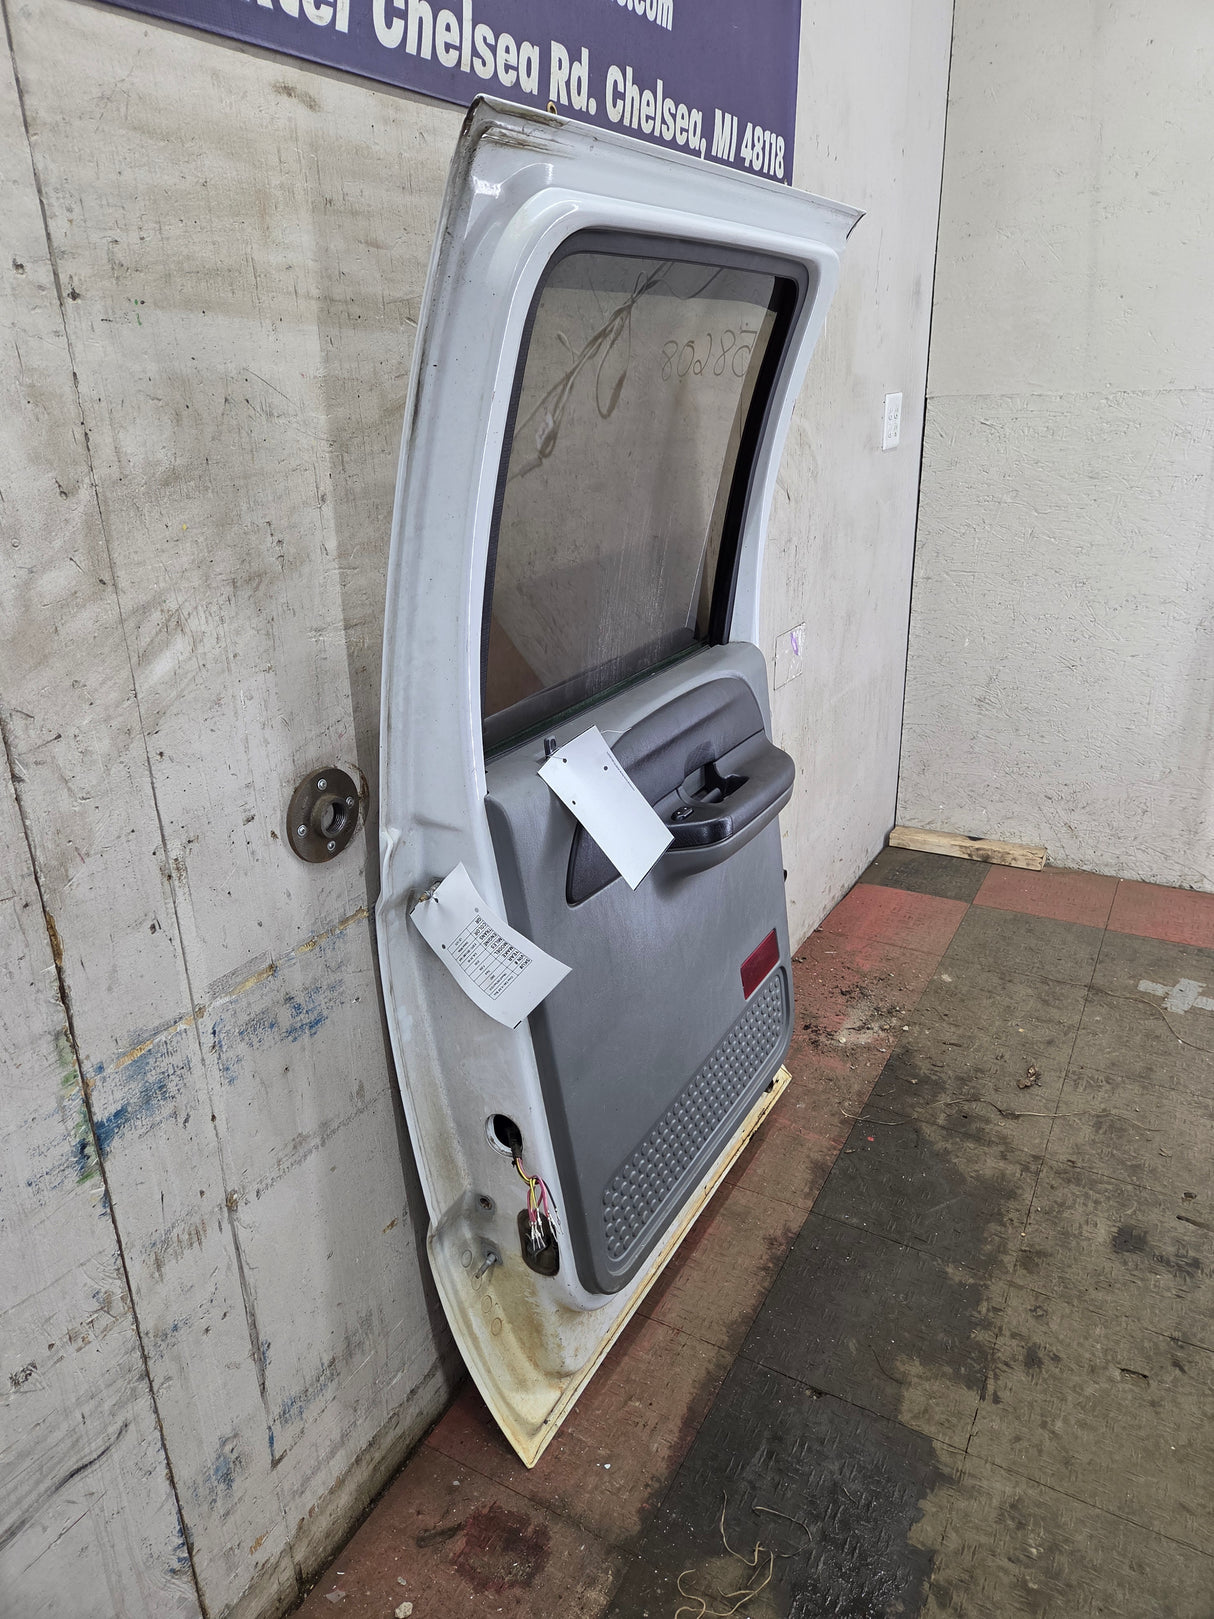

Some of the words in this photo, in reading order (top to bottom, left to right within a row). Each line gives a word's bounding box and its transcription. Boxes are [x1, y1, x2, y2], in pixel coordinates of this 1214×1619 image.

[373, 0, 540, 95] Chelsea
[549, 40, 597, 115] Rd.
[606, 65, 707, 160] Chelsea,
[711, 108, 738, 162] MI
[740, 122, 785, 179] 48118
[494, 942, 508, 955] MODEL
[501, 946, 514, 958] MAKE
[508, 950, 519, 962] YEAR
